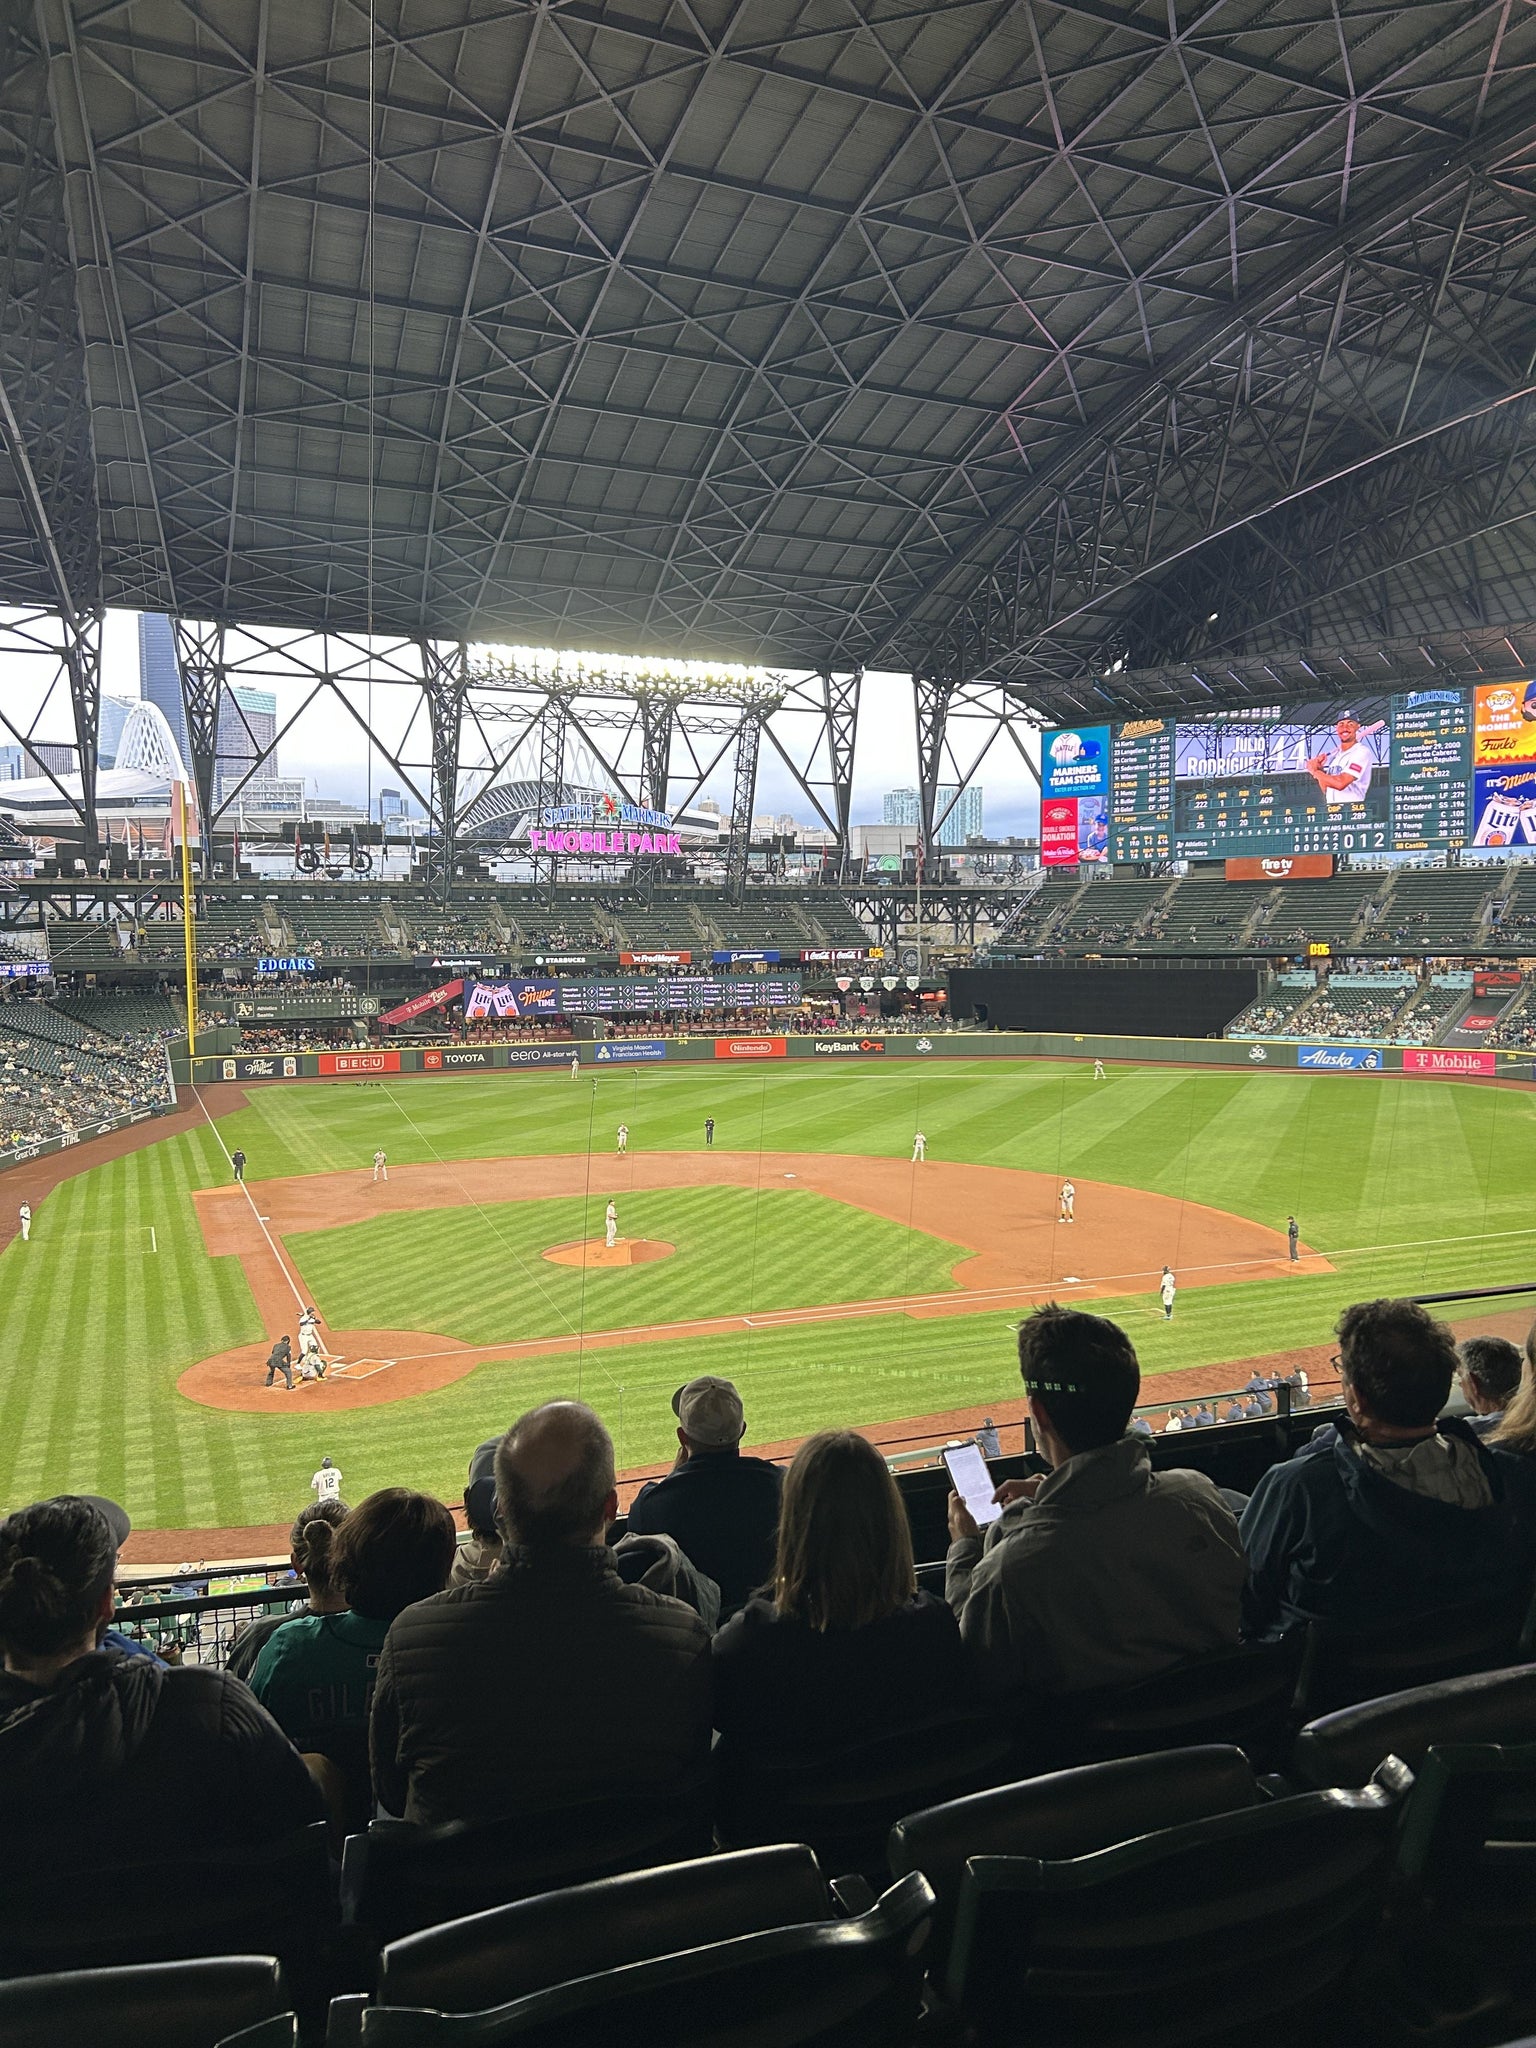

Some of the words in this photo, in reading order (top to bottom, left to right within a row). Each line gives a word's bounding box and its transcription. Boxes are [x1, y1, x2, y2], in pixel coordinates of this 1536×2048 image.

[1404, 711, 1437, 720] Refsnyder
[1490, 713, 1511, 722] THE
[1404, 721, 1429, 730] Raleigh
[1452, 726, 1467, 734] .222
[1477, 721, 1523, 733] MOMENT
[1231, 736, 1266, 754] JULIO
[1401, 745, 1432, 753] December
[1444, 741, 1461, 749] 2000
[1480, 737, 1518, 752] Funko
[1269, 735, 1307, 772] 44
[1431, 749, 1457, 757] Cabrera
[1400, 758, 1433, 766] Dominican
[1433, 756, 1461, 764] Republic
[1053, 765, 1098, 777] MARINERS
[1049, 776, 1075, 787] TEAM
[1075, 774, 1102, 785] STORE
[1259, 788, 1273, 796] OPS
[1403, 784, 1425, 792] Naylor
[1403, 793, 1437, 801] Arozarena
[1194, 801, 1209, 809] .222
[543, 804, 595, 826] SEATTLE
[620, 803, 674, 831] MARINERS
[1196, 821, 1206, 829] 25
[1217, 820, 1227, 828] 90
[1239, 818, 1249, 826] 20
[1284, 816, 1293, 824] 10
[1307, 814, 1316, 822] 11
[1327, 813, 1343, 821] .320
[1351, 812, 1367, 820] .289
[1403, 812, 1425, 820] Garver
[1488, 809, 1518, 829] Lite
[1402, 822, 1423, 830] Young
[528, 829, 625, 854] T-MOBILE
[627, 832, 683, 857] PARK
[1042, 832, 1077, 842] DONATION
[1184, 839, 1209, 847] Athletics
[1343, 834, 1354, 849] 0
[1359, 833, 1367, 848] 1
[1374, 832, 1385, 848] 2
[1184, 849, 1209, 857] Mariners
[1313, 843, 1319, 851] 0
[1332, 842, 1338, 850] 2
[1404, 841, 1429, 849] Castillo
[1261, 859, 1279, 869] fire
[1279, 859, 1294, 869] tv
[1309, 944, 1330, 956] 0:06
[412, 999, 431, 1011] Mobile
[429, 990, 448, 1004] Pen
[475, 992, 490, 1005] Lite
[498, 993, 513, 1007] Lite
[518, 989, 556, 1007] Miller
[537, 999, 556, 1007] TIME
[612, 1045, 633, 1053] Virginia
[734, 1044, 769, 1052] Nintendo
[815, 1042, 860, 1053] KeyBank
[445, 1053, 486, 1063] TOYOTA
[510, 1050, 541, 1061] eero
[542, 1050, 565, 1060] All-star
[642, 1050, 663, 1058] Health
[1302, 1050, 1355, 1068] Alaska
[1431, 1053, 1482, 1069] Mobile
[62, 1132, 80, 1148] STIHL
[15, 1150, 29, 1161] Great
[28, 1147, 40, 1158] Clips
[325, 1477, 335, 1489] 12
